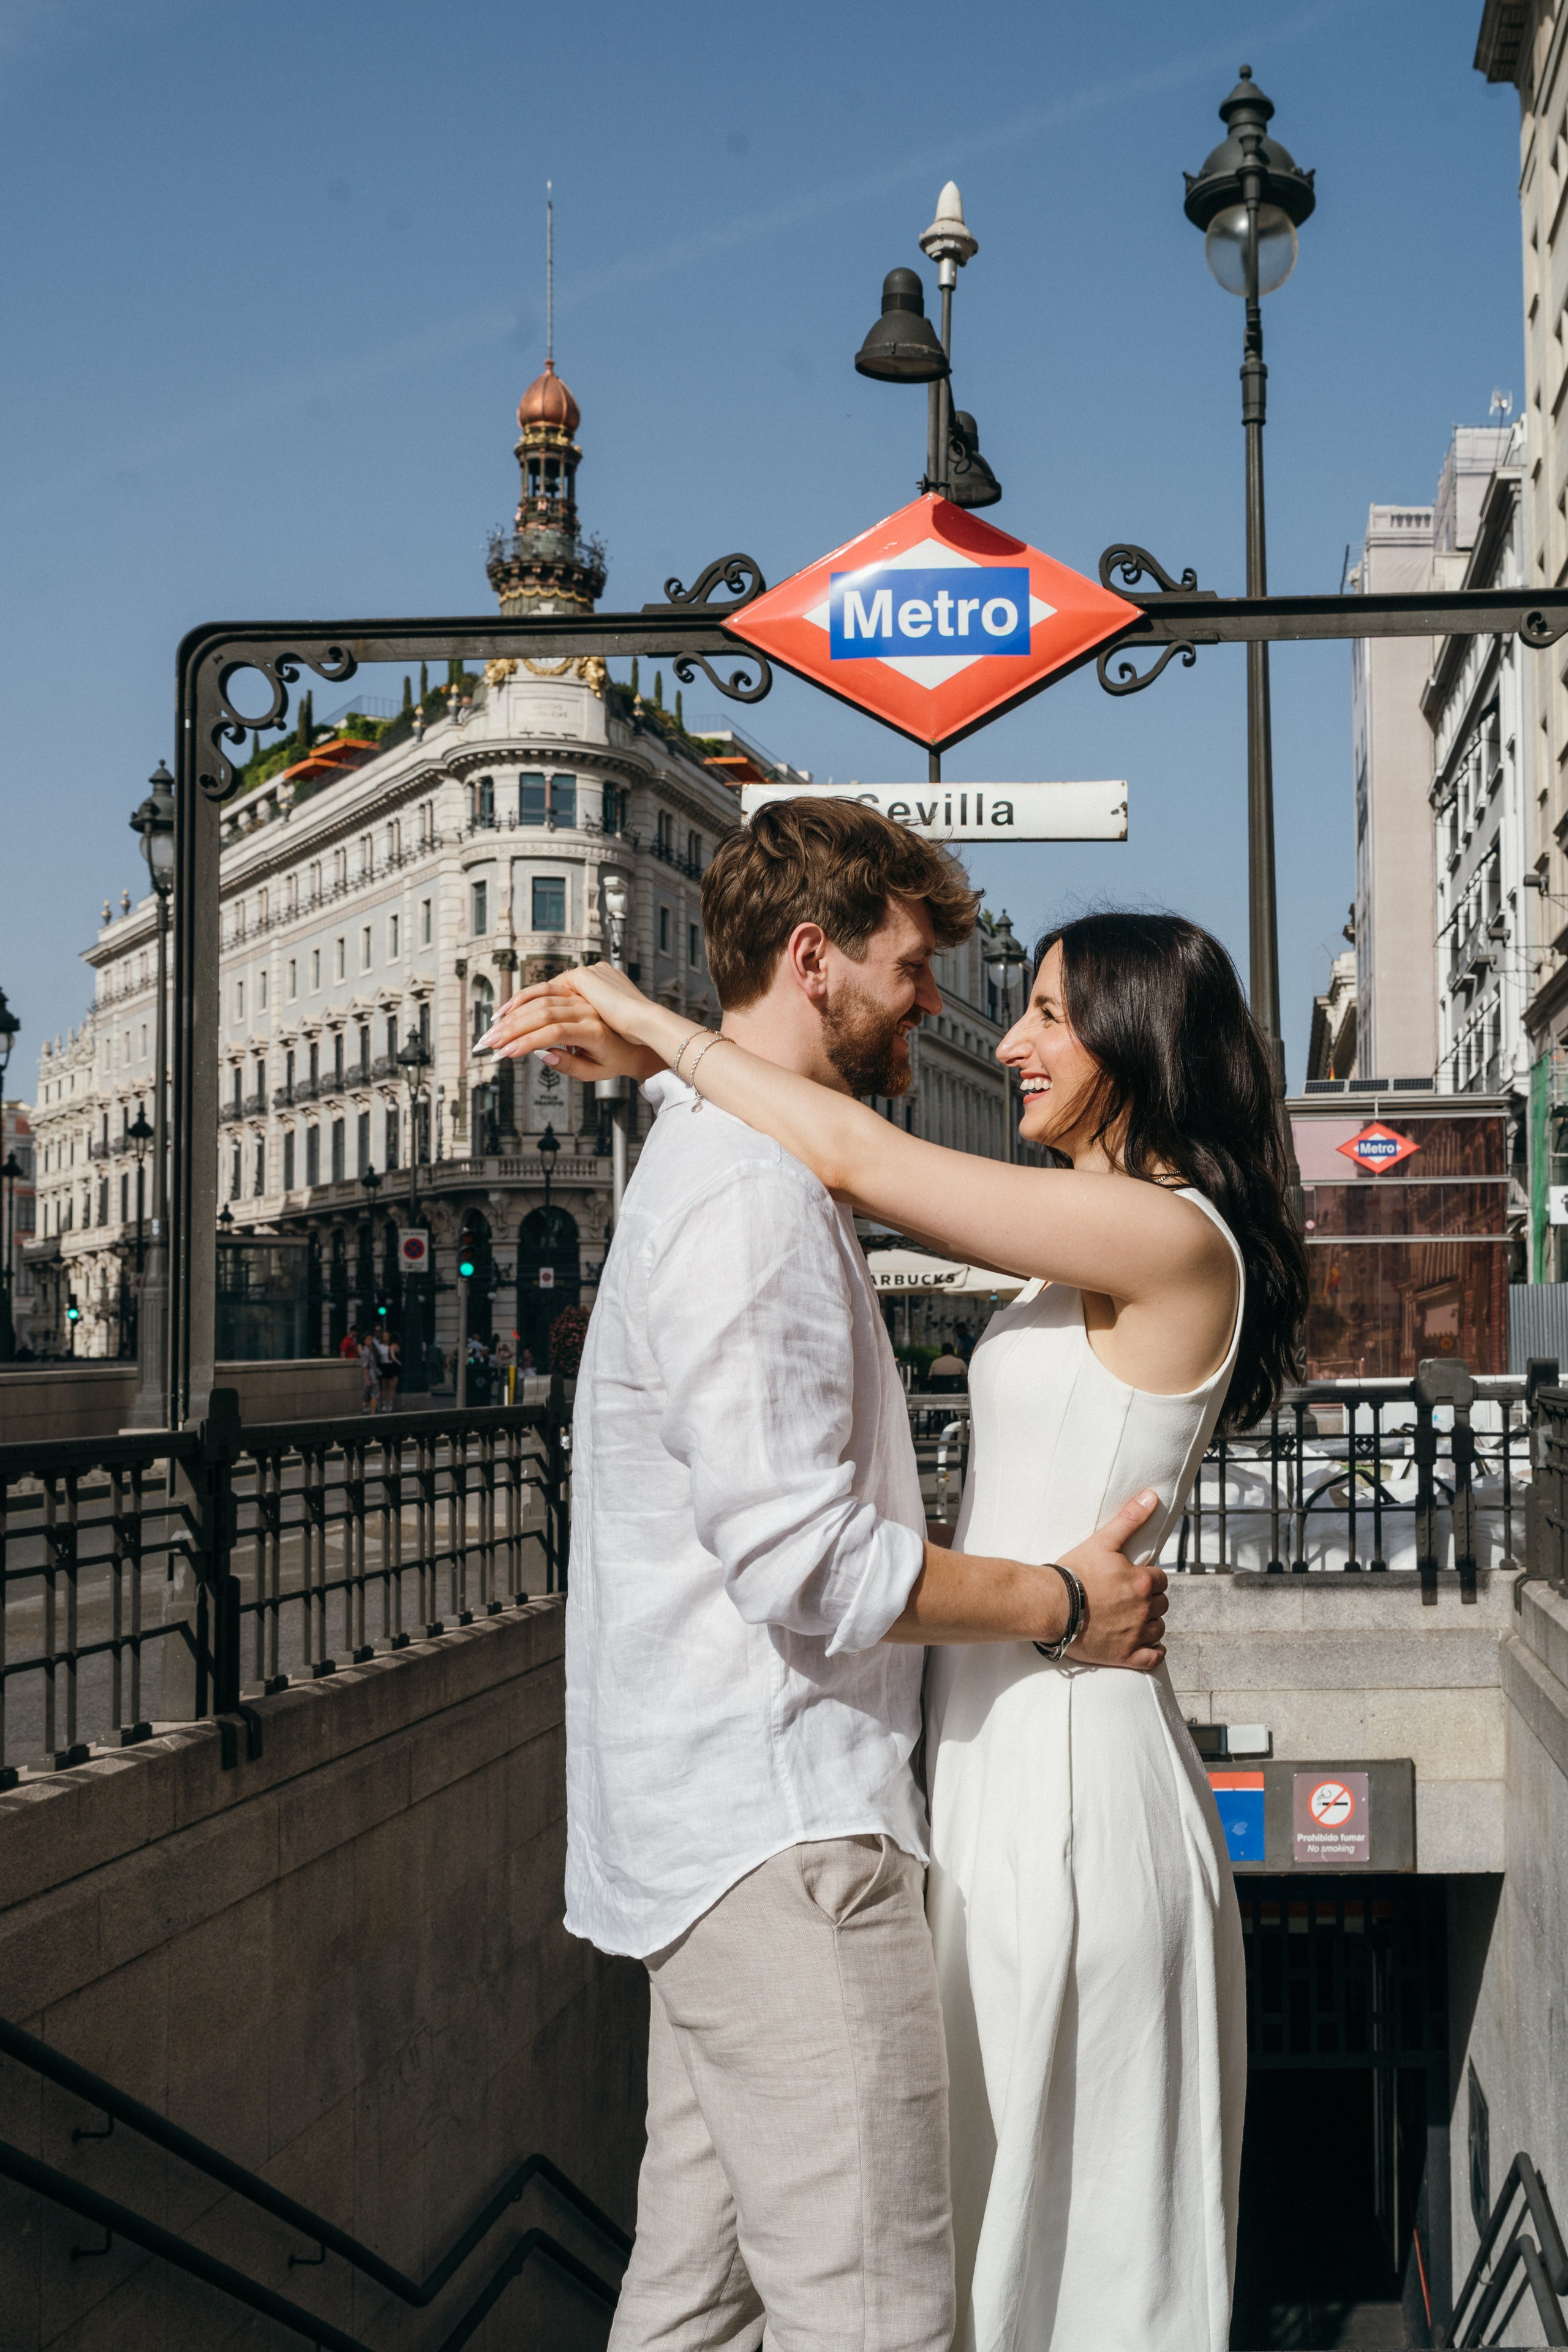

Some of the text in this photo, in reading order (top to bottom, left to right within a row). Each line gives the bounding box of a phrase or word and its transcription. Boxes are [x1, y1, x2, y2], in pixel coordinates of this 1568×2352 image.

[843, 589, 1018, 639] Metro
[1360, 1142, 1395, 1154] Metro
[870, 1273, 956, 1286] ARBUCKS
[1297, 1833, 1339, 1842] Prohibido
[1306, 1844, 1355, 1855] No smoking
